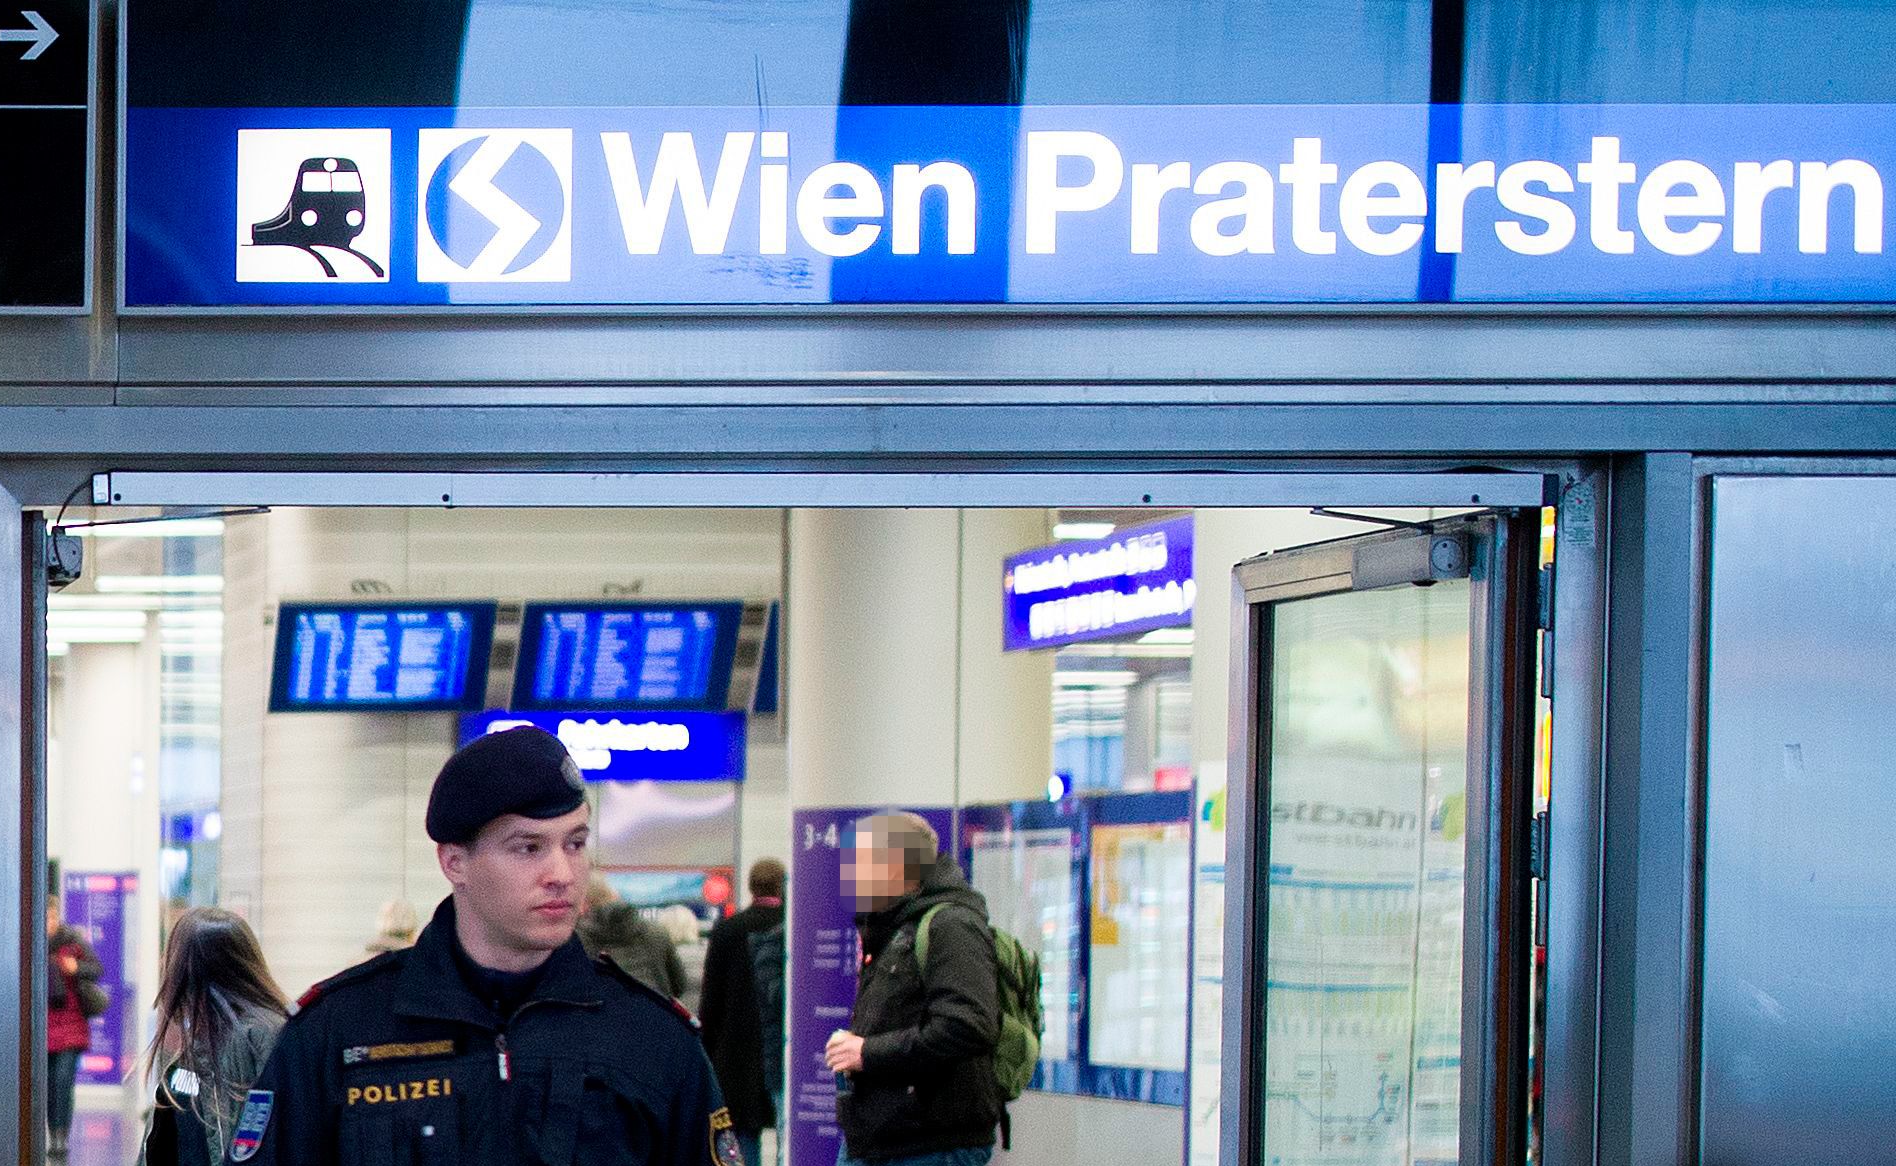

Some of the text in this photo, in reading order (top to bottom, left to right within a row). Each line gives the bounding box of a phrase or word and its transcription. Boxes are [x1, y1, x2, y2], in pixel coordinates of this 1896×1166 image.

[600, 130, 1884, 257] Wien Praterstern
[1272, 803, 1416, 831] stbahn
[347, 1078, 452, 1105] POLIZEI
